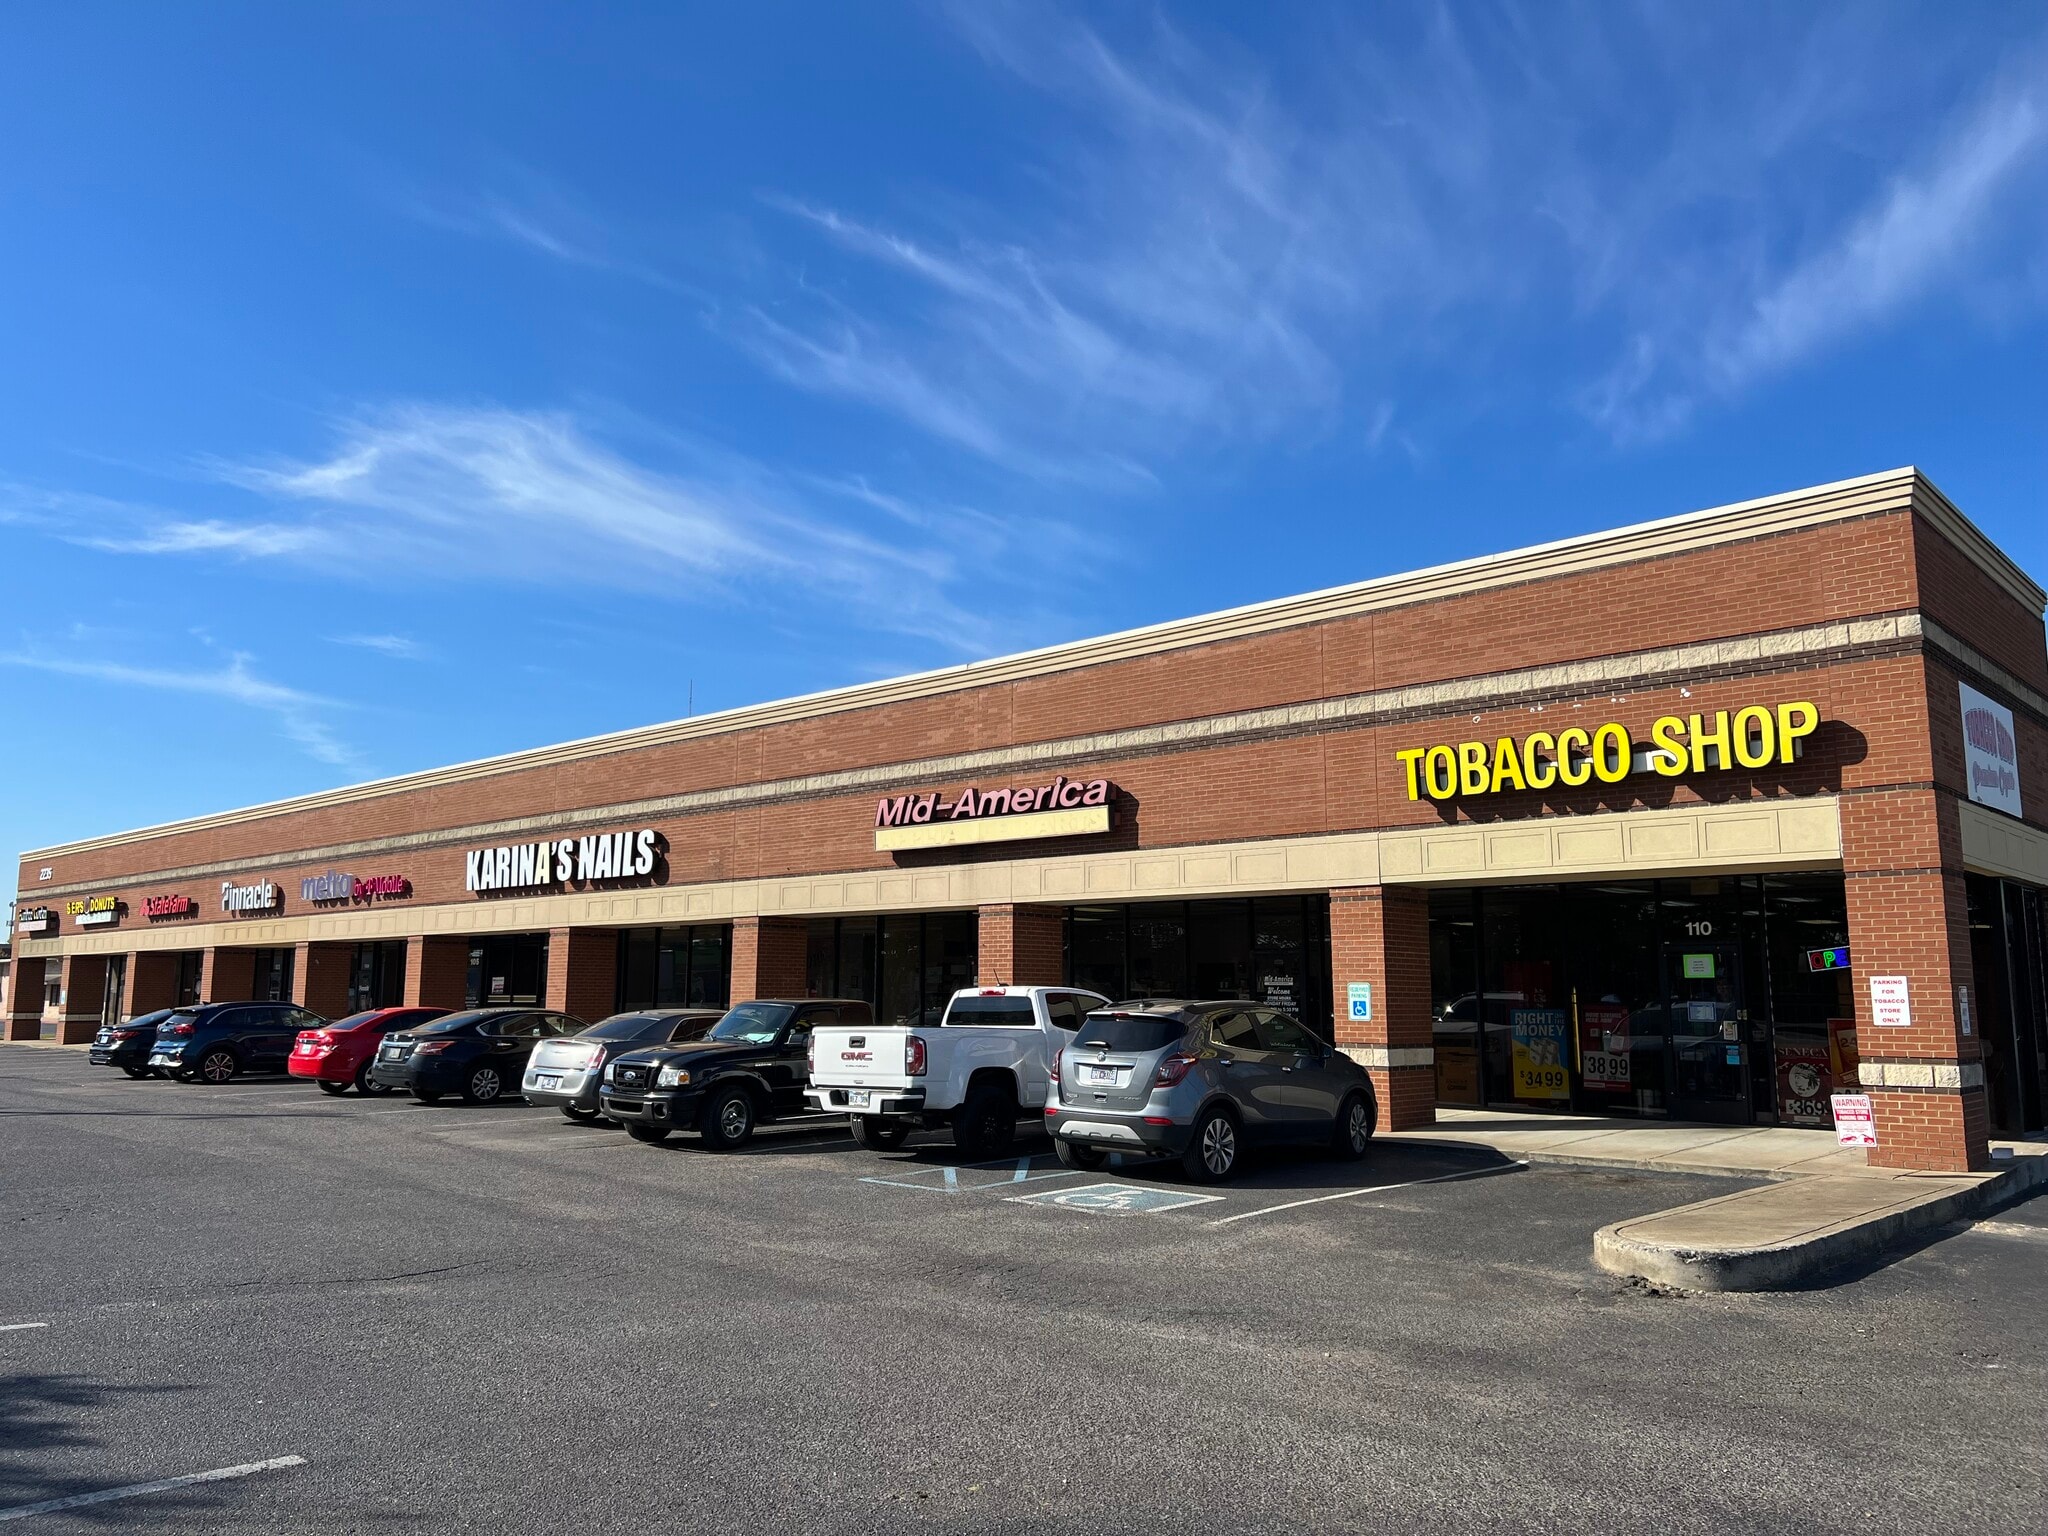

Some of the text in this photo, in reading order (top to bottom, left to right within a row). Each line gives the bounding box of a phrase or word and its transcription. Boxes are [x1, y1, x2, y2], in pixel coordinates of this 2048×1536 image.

[1396, 701, 1818, 801] TOBACCO SHOP
[874, 775, 1109, 827] Mid-America
[466, 829, 655, 891] KARINA'S NAILS
[301, 870, 352, 900] metro
[222, 878, 273, 911] Pinnacle
[90, 896, 115, 911] DONUTS
[1685, 921, 1712, 936] 110
[1810, 948, 1850, 968] OPE
[1515, 1012, 1553, 1025] RIGHT
[1515, 1024, 1565, 1037] MONEY
[841, 1052, 873, 1061] GMC
[1779, 1047, 1829, 1058] SENECA
[1835, 1098, 1867, 1107] WARNING
